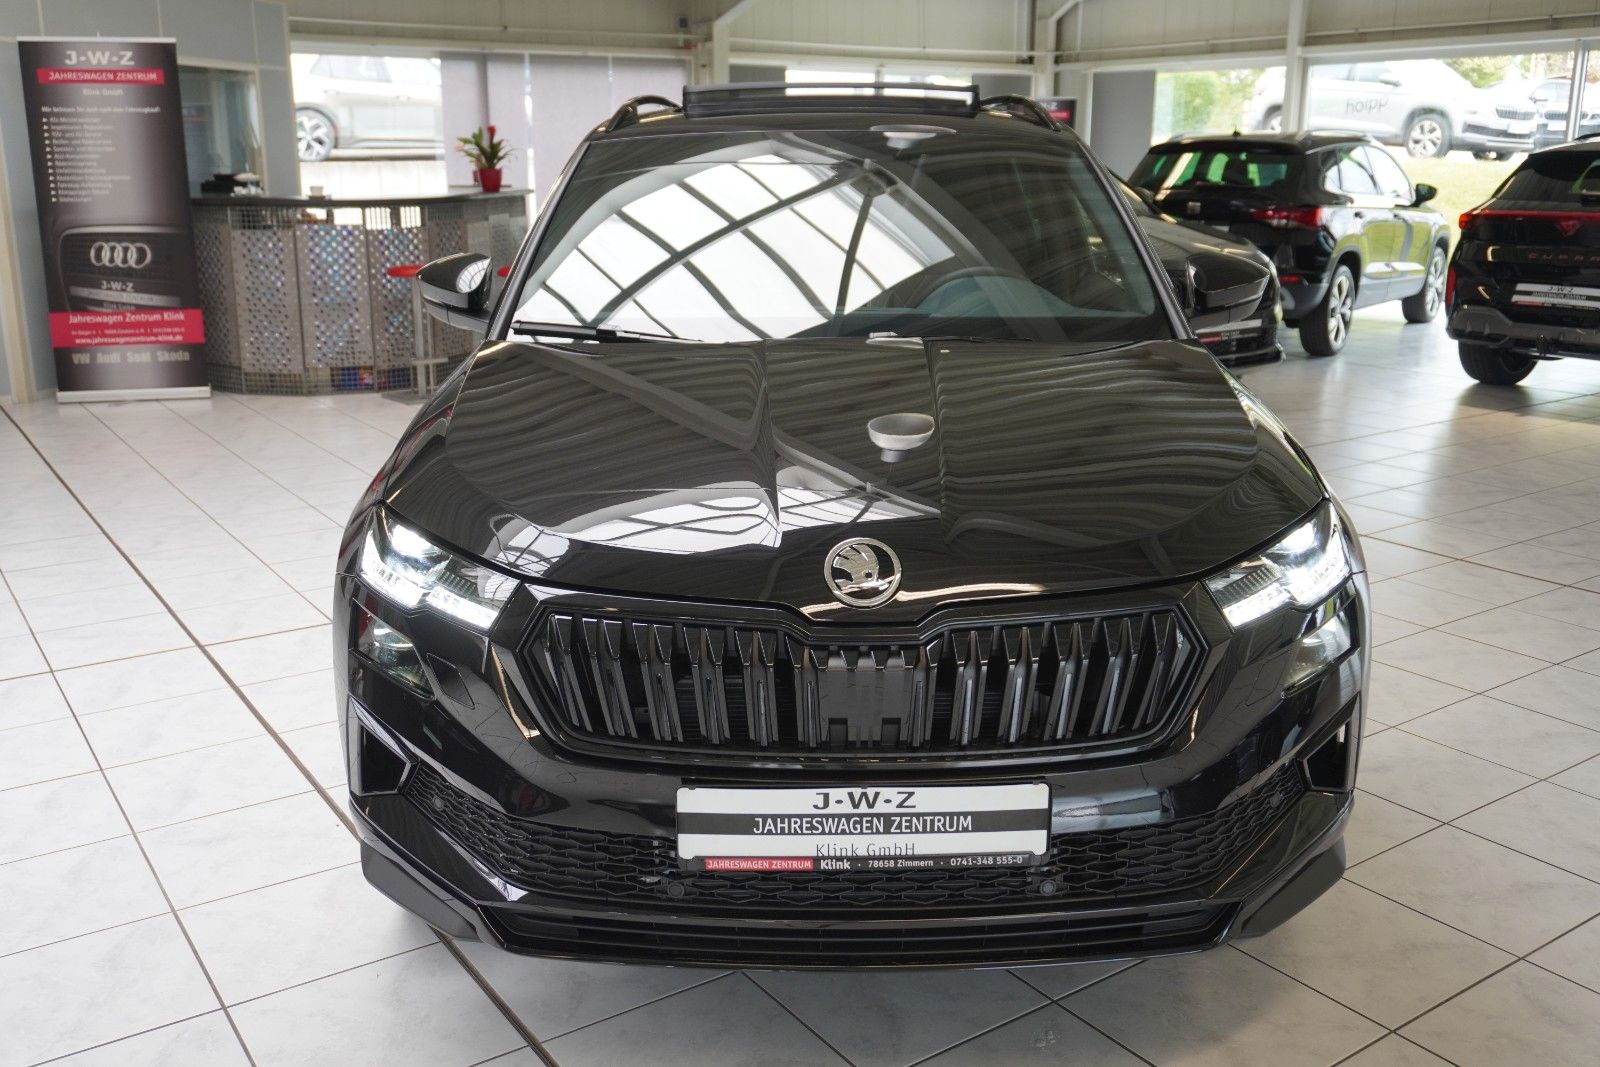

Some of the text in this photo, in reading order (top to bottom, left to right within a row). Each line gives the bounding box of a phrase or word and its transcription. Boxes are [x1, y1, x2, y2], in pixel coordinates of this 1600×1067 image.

[48, 71, 157, 81] JAHRESWAGEN ZENTRUM
[69, 311, 185, 325] Jahreswagen Zentrum Klink
[72, 353, 91, 365] VW
[97, 352, 121, 363] Audi
[753, 815, 973, 834] JAHRESWAGEN ZENTRUM
[816, 842, 916, 857] Klink GmbH
[707, 856, 1023, 870] JAHRESWAGEN ZENTRUM Klink 78658 Zimmern 0741-348 555-0
